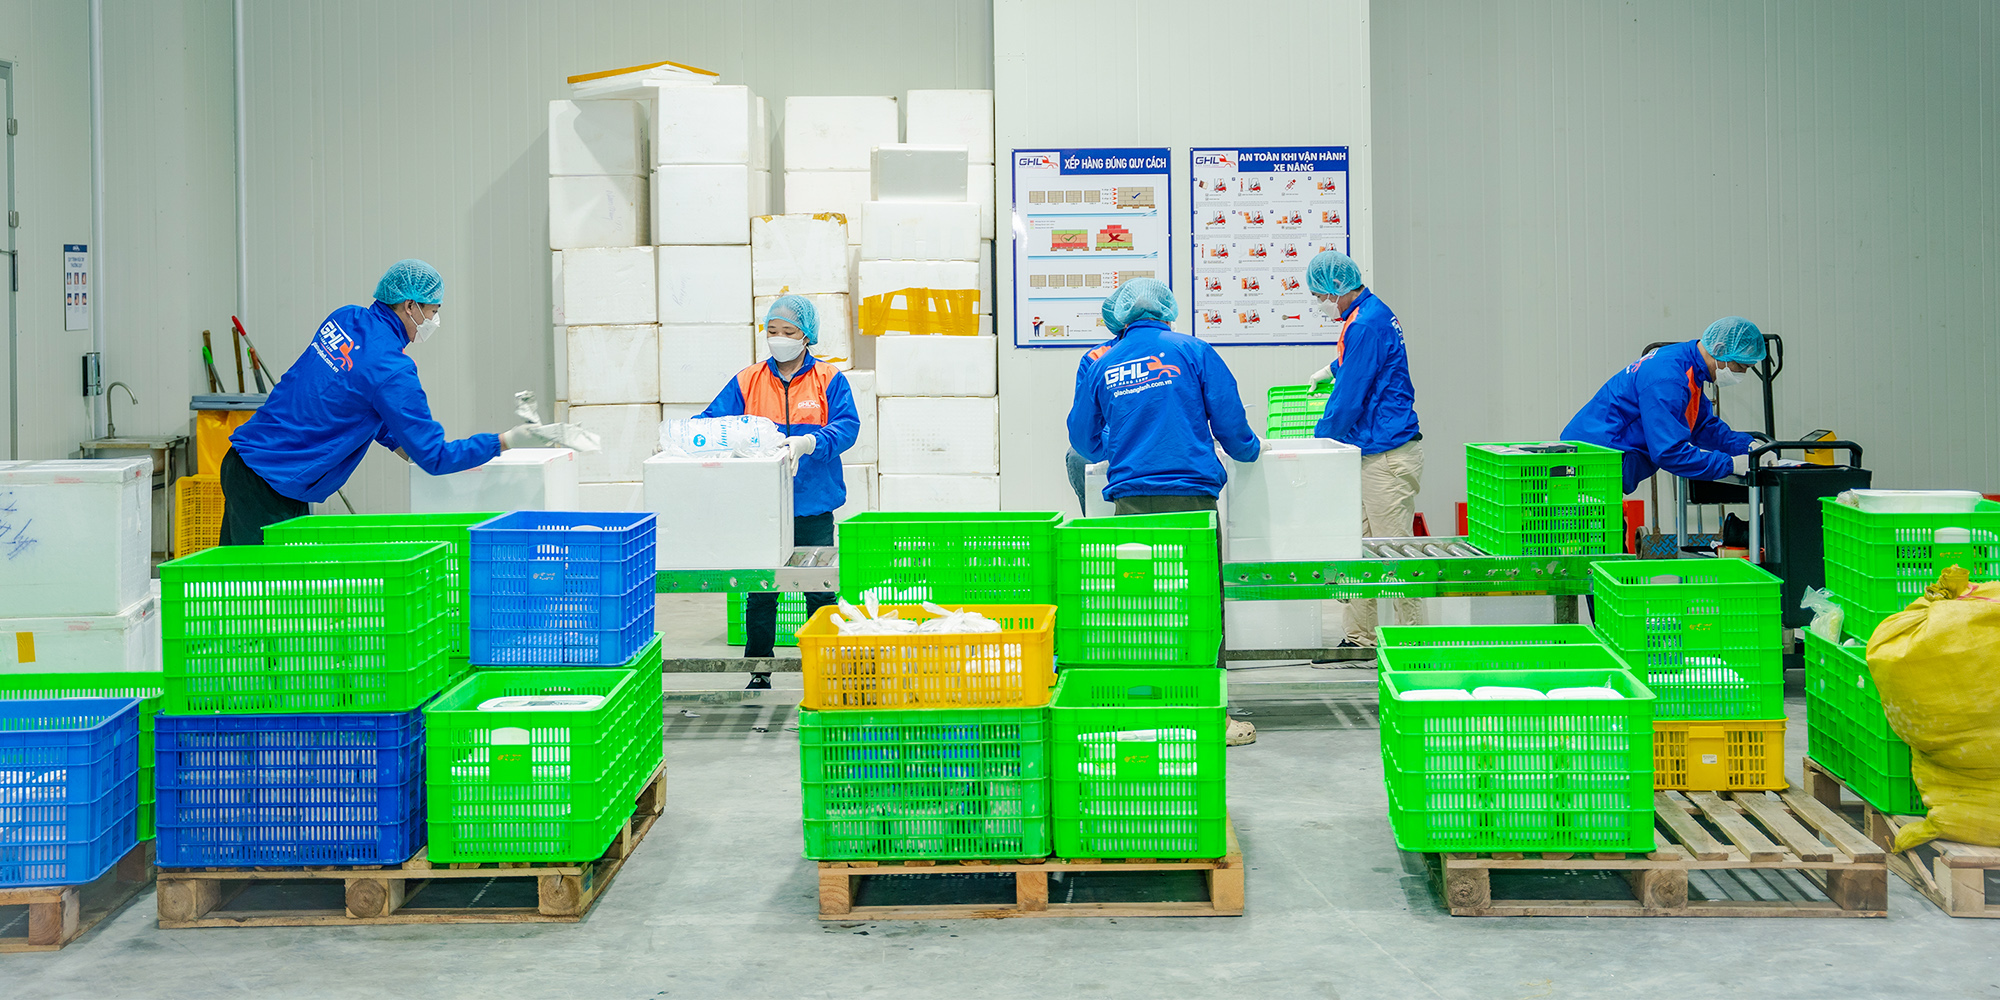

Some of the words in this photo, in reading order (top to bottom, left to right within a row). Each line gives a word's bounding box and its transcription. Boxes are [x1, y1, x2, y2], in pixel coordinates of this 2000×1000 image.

[1018, 158, 1043, 167] GHL
[1064, 154, 1081, 169] XẾP
[1081, 156, 1104, 169] HÀNG
[1105, 155, 1128, 169] ĐÚNG
[1128, 158, 1145, 169] QUY
[1145, 156, 1167, 169] CÁCH
[1195, 156, 1220, 165] GHL
[1239, 153, 1253, 161] AN
[1253, 151, 1280, 161] TOÀN
[1281, 153, 1297, 161] KHI
[1298, 151, 1318, 163] VẬN
[1319, 151, 1346, 161] HÀNH
[1273, 163, 1286, 172] XE
[1286, 162, 1315, 172] NÂNG
[320, 320, 345, 351] GHL
[1104, 362, 1150, 385] GHL
[1113, 379, 1173, 398] giaohanglanh.com.vn
